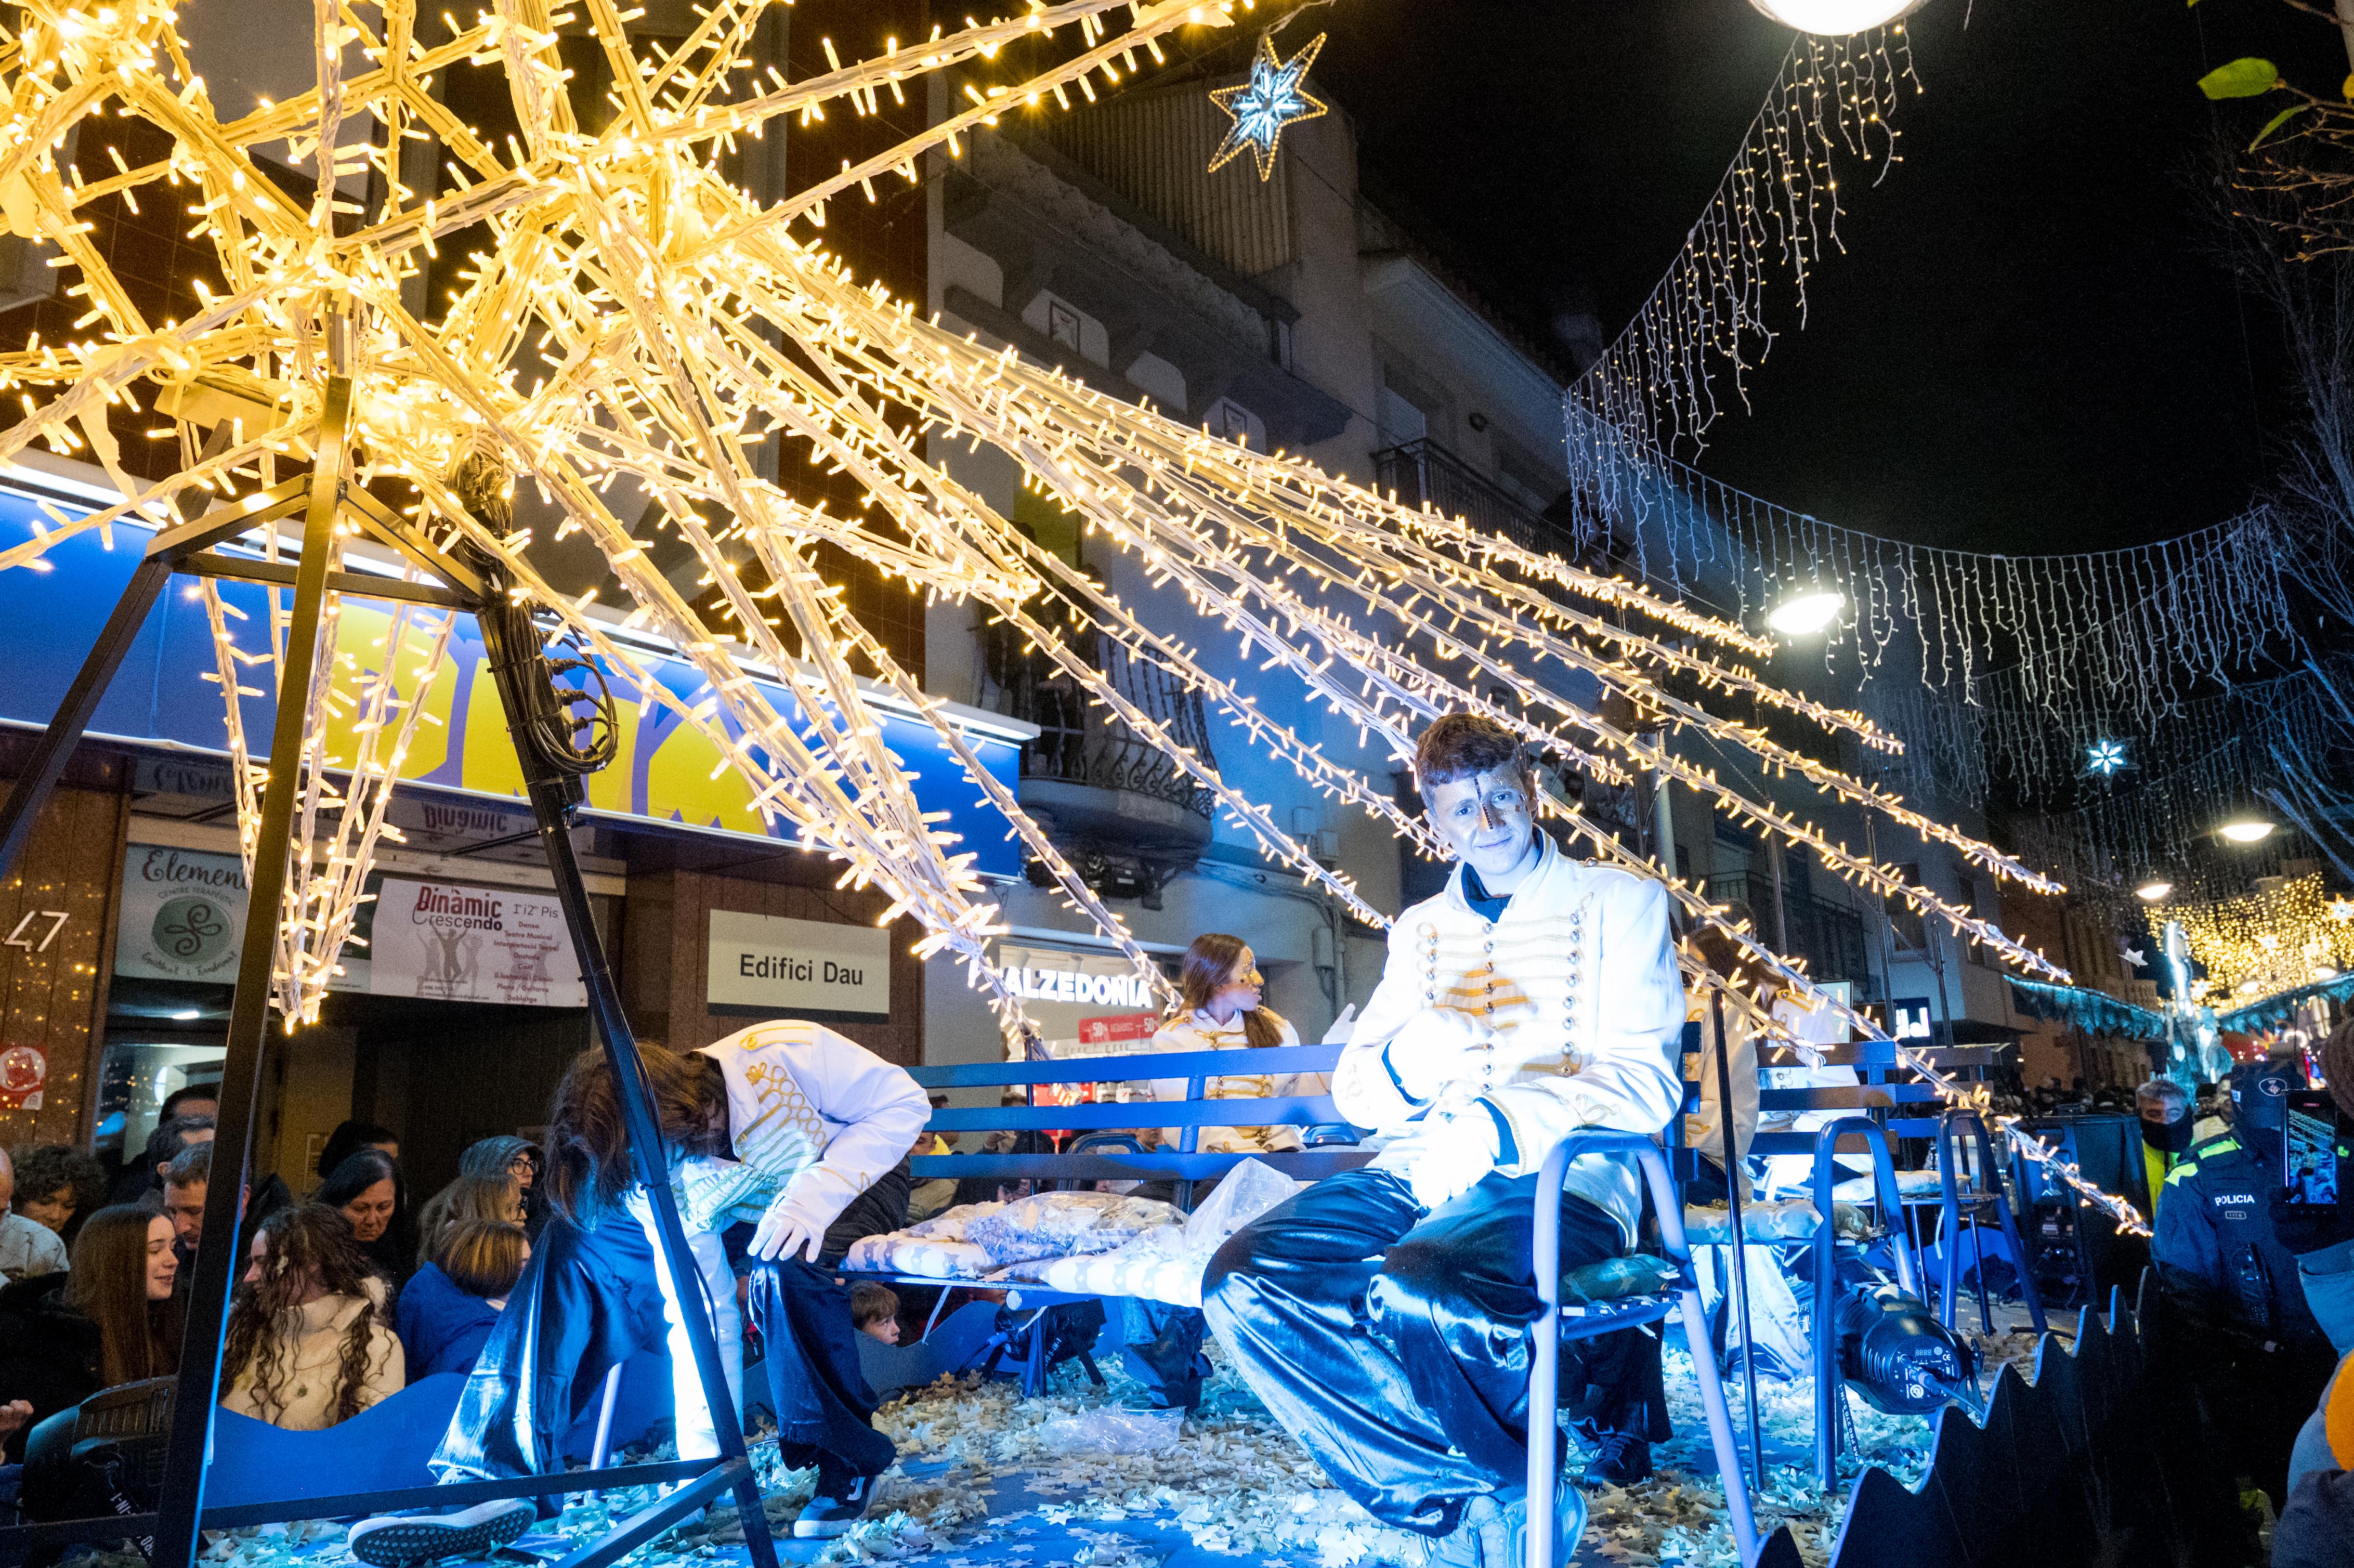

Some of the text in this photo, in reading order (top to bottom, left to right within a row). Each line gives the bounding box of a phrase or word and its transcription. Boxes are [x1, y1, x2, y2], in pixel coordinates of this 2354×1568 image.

[417, 885, 502, 919] Dinàmic
[541, 906, 559, 918] Pis
[412, 903, 503, 931] Crescendo
[527, 932, 553, 940] Musical
[740, 953, 863, 985] Edifici Dau
[998, 965, 1153, 1009] ALZEDONIA
[507, 995, 538, 1004] Doblatge
[2215, 1194, 2255, 1206] POLICIA
